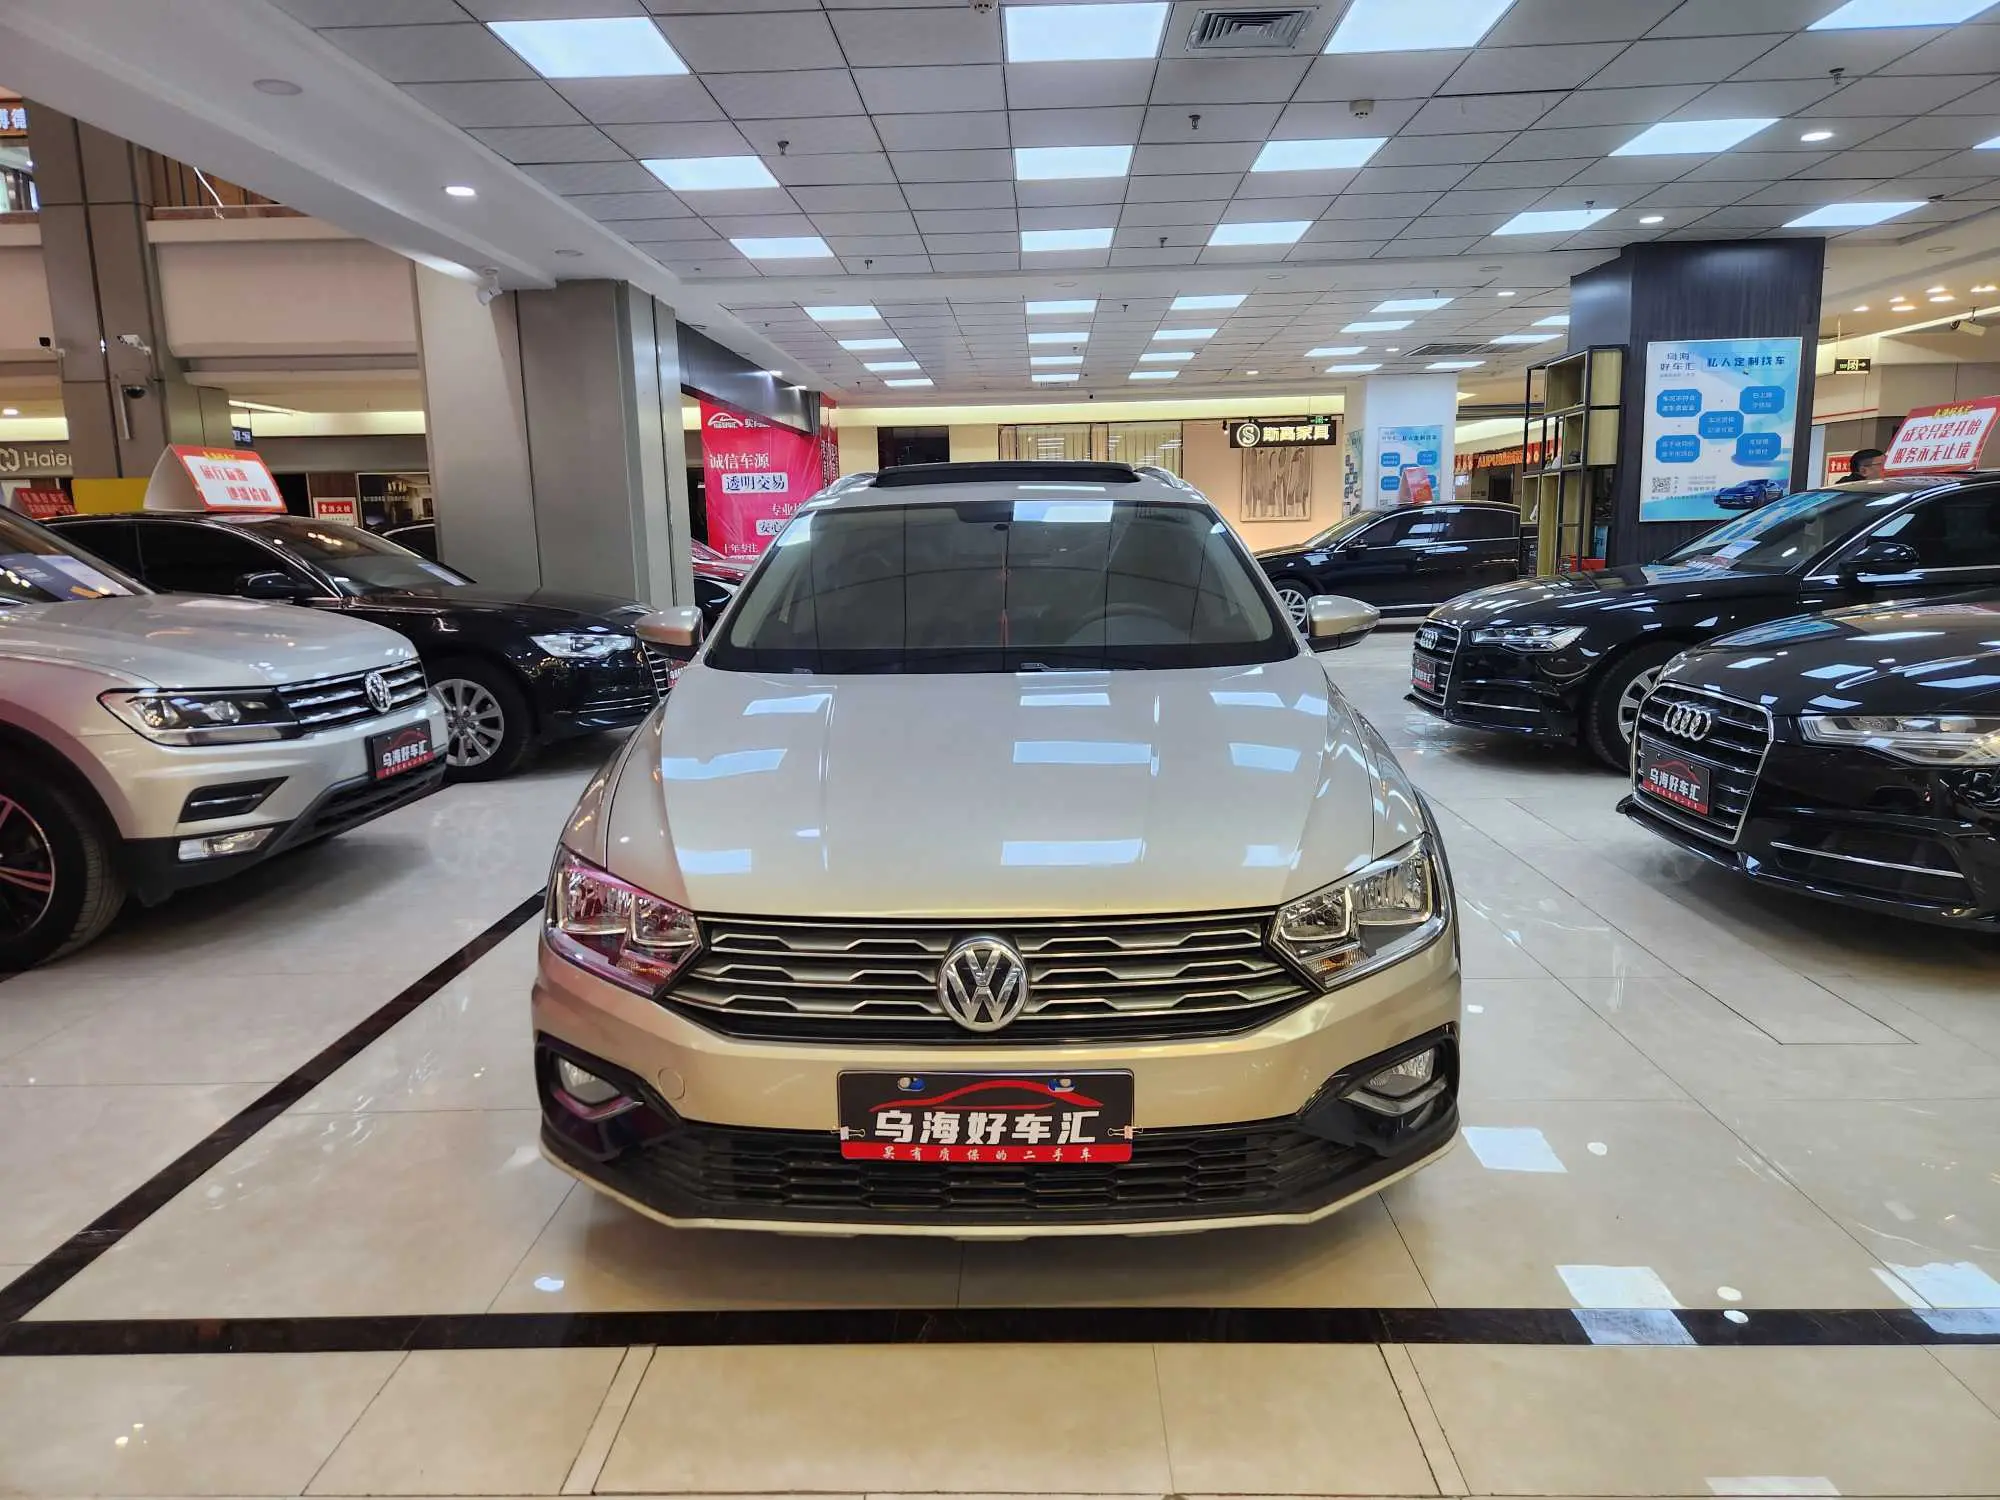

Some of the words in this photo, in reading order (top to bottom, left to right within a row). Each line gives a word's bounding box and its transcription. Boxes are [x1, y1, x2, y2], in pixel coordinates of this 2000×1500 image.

[1706, 356, 1786, 368] 私人定制找车
[1901, 418, 1983, 443] 成交只是开始
[709, 453, 770, 470] 诚信车源
[1892, 442, 1972, 465] 服务永无止境
[726, 475, 785, 491] 透明交易
[1650, 768, 1700, 801] 乌海好车汇
[875, 1109, 1100, 1145] 乌海好车汇
[882, 1146, 1094, 1162] 买有质保的二手车
